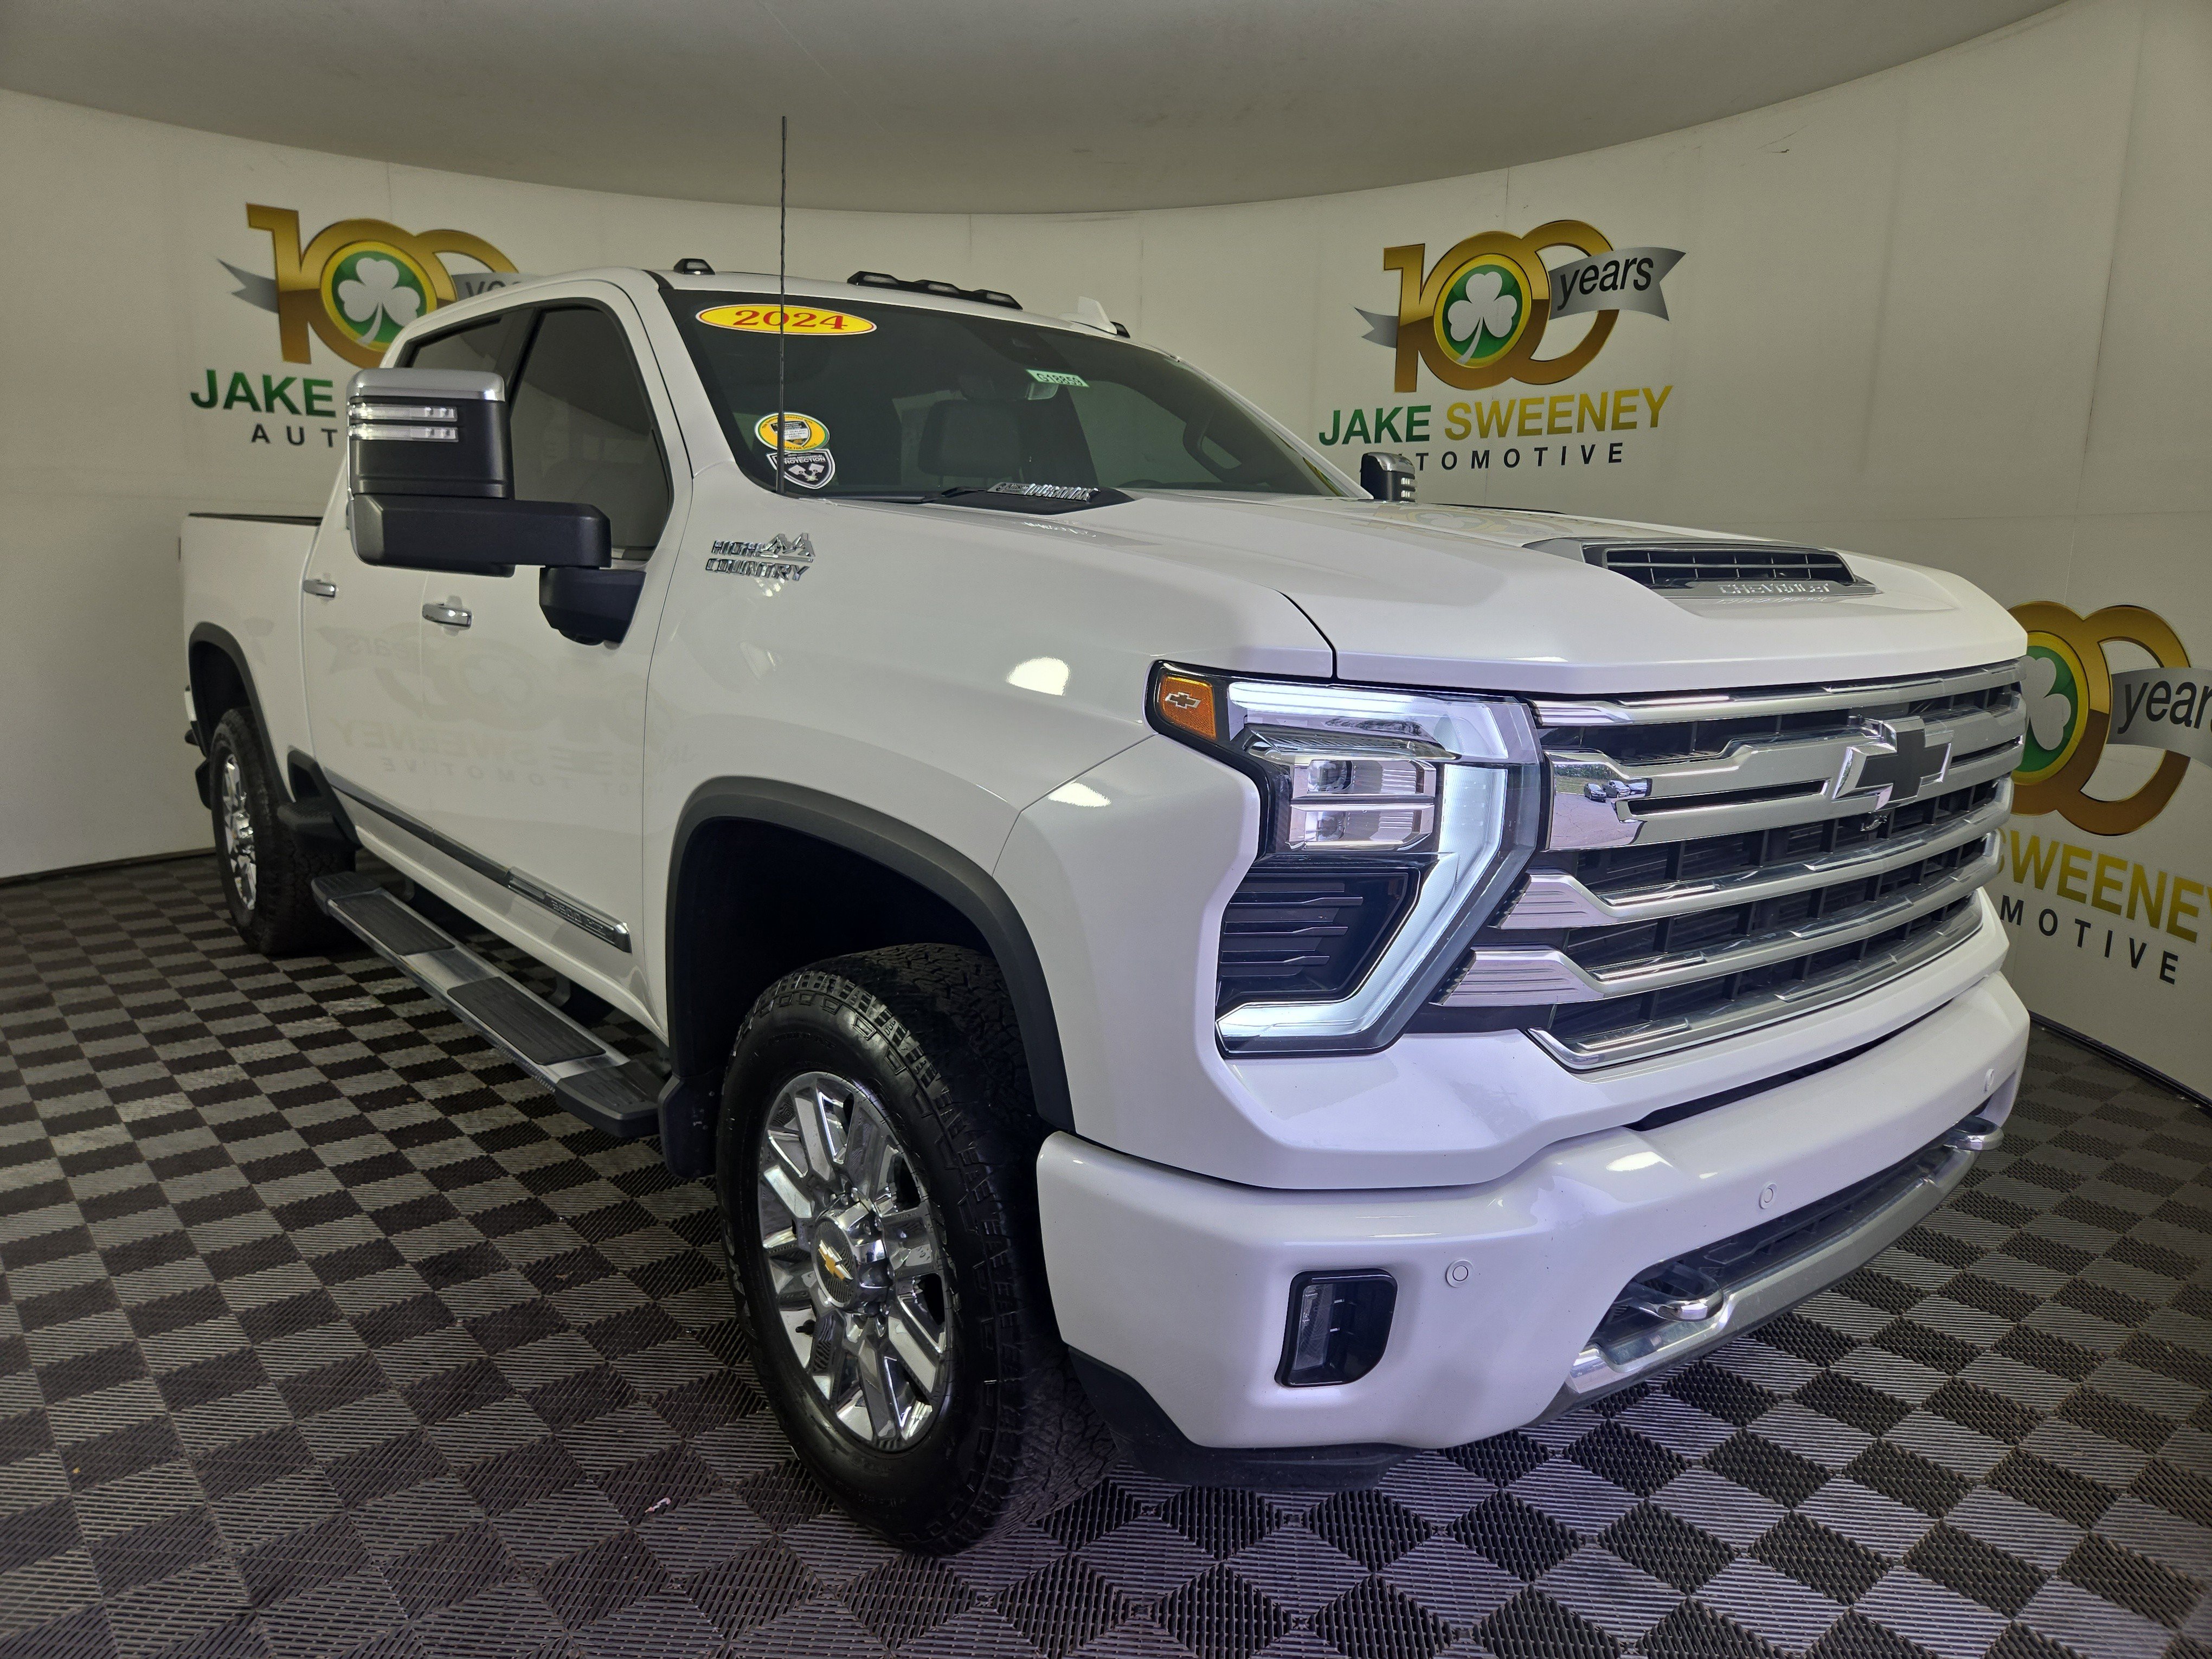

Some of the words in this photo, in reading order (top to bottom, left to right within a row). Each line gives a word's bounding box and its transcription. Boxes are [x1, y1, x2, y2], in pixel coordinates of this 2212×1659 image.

[1557, 255, 1654, 311] years
[733, 310, 847, 330] 2024
[190, 369, 337, 418] JAKE
[1319, 404, 1432, 446] JAKE
[1444, 385, 1673, 441] SWEENEY
[251, 424, 338, 448] AUT
[784, 456, 826, 465] ROTECTION
[1360, 442, 1623, 472] TOMOTIVE
[1026, 483, 1100, 502] DURAMAX
[711, 541, 763, 557] HIGH
[705, 558, 810, 582] COUNTRY
[1718, 583, 1830, 594] CHEVROLET
[2117, 678, 2212, 735] year
[1997, 827, 2212, 952] WEENE
[2000, 895, 2179, 985] MOTIVE
